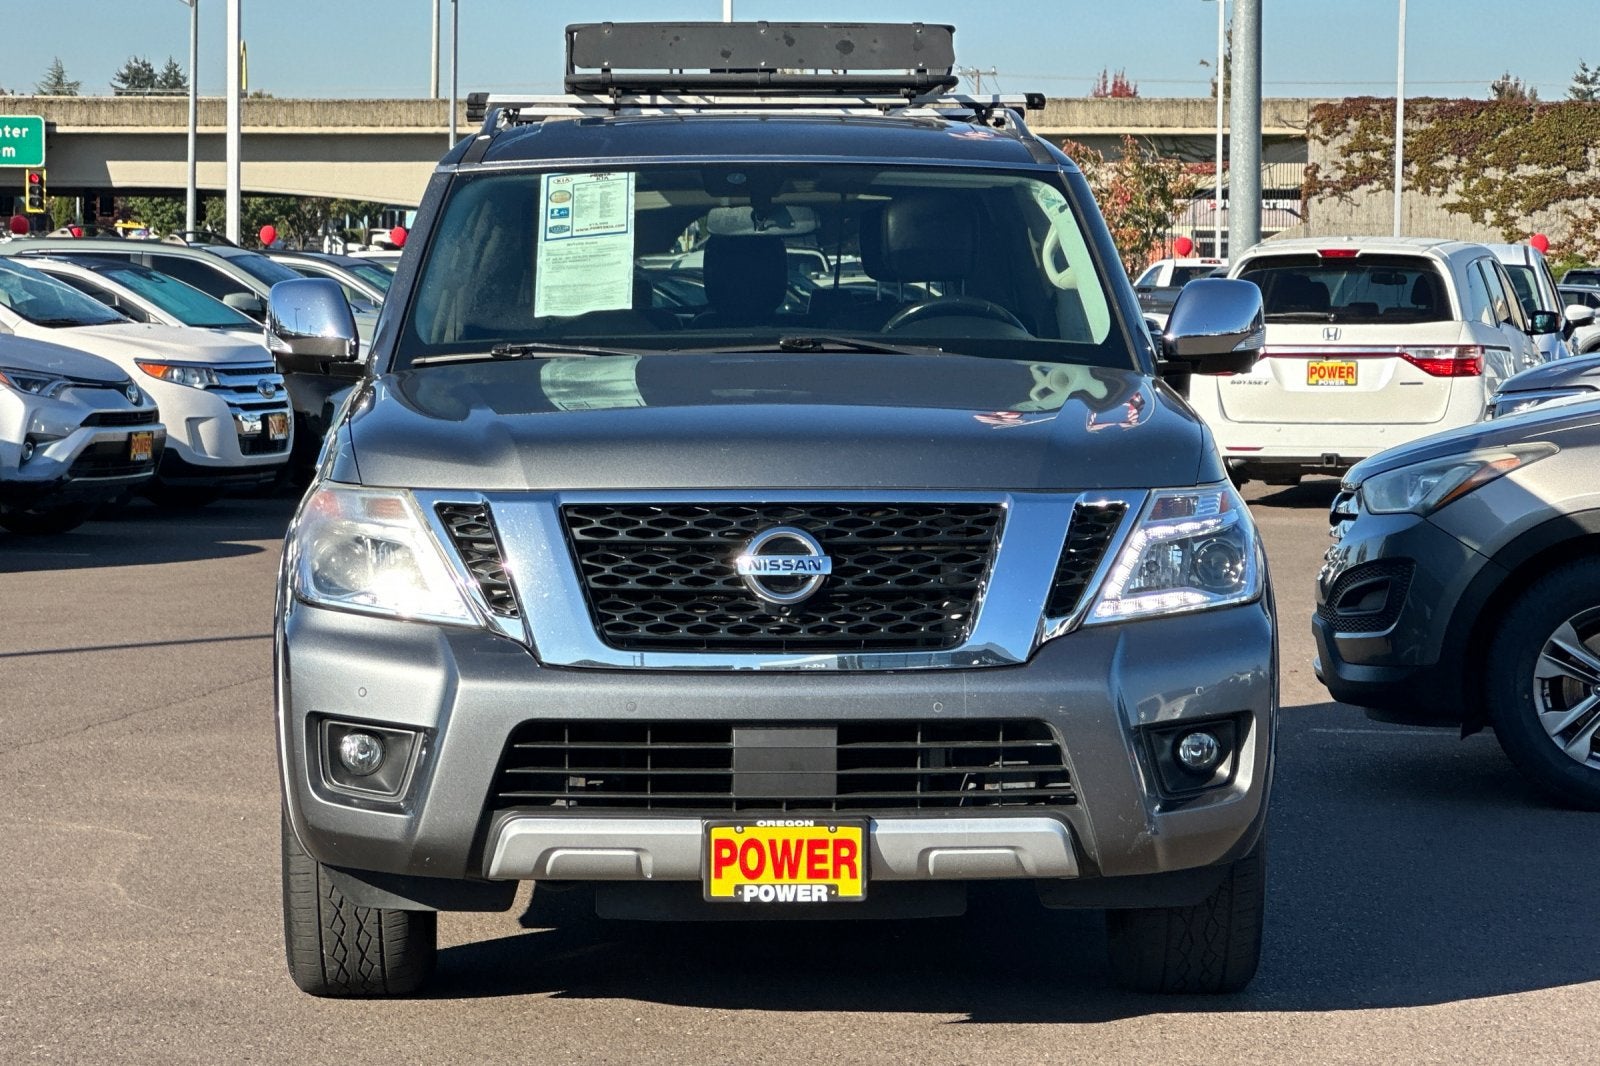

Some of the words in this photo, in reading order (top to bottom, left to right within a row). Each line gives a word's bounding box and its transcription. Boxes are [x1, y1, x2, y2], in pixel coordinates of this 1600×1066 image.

[0, 125, 29, 138] ter
[1310, 366, 1354, 379] POWER
[748, 559, 821, 571] NISSAN
[714, 838, 858, 880] POWER
[743, 884, 828, 902] POWER
